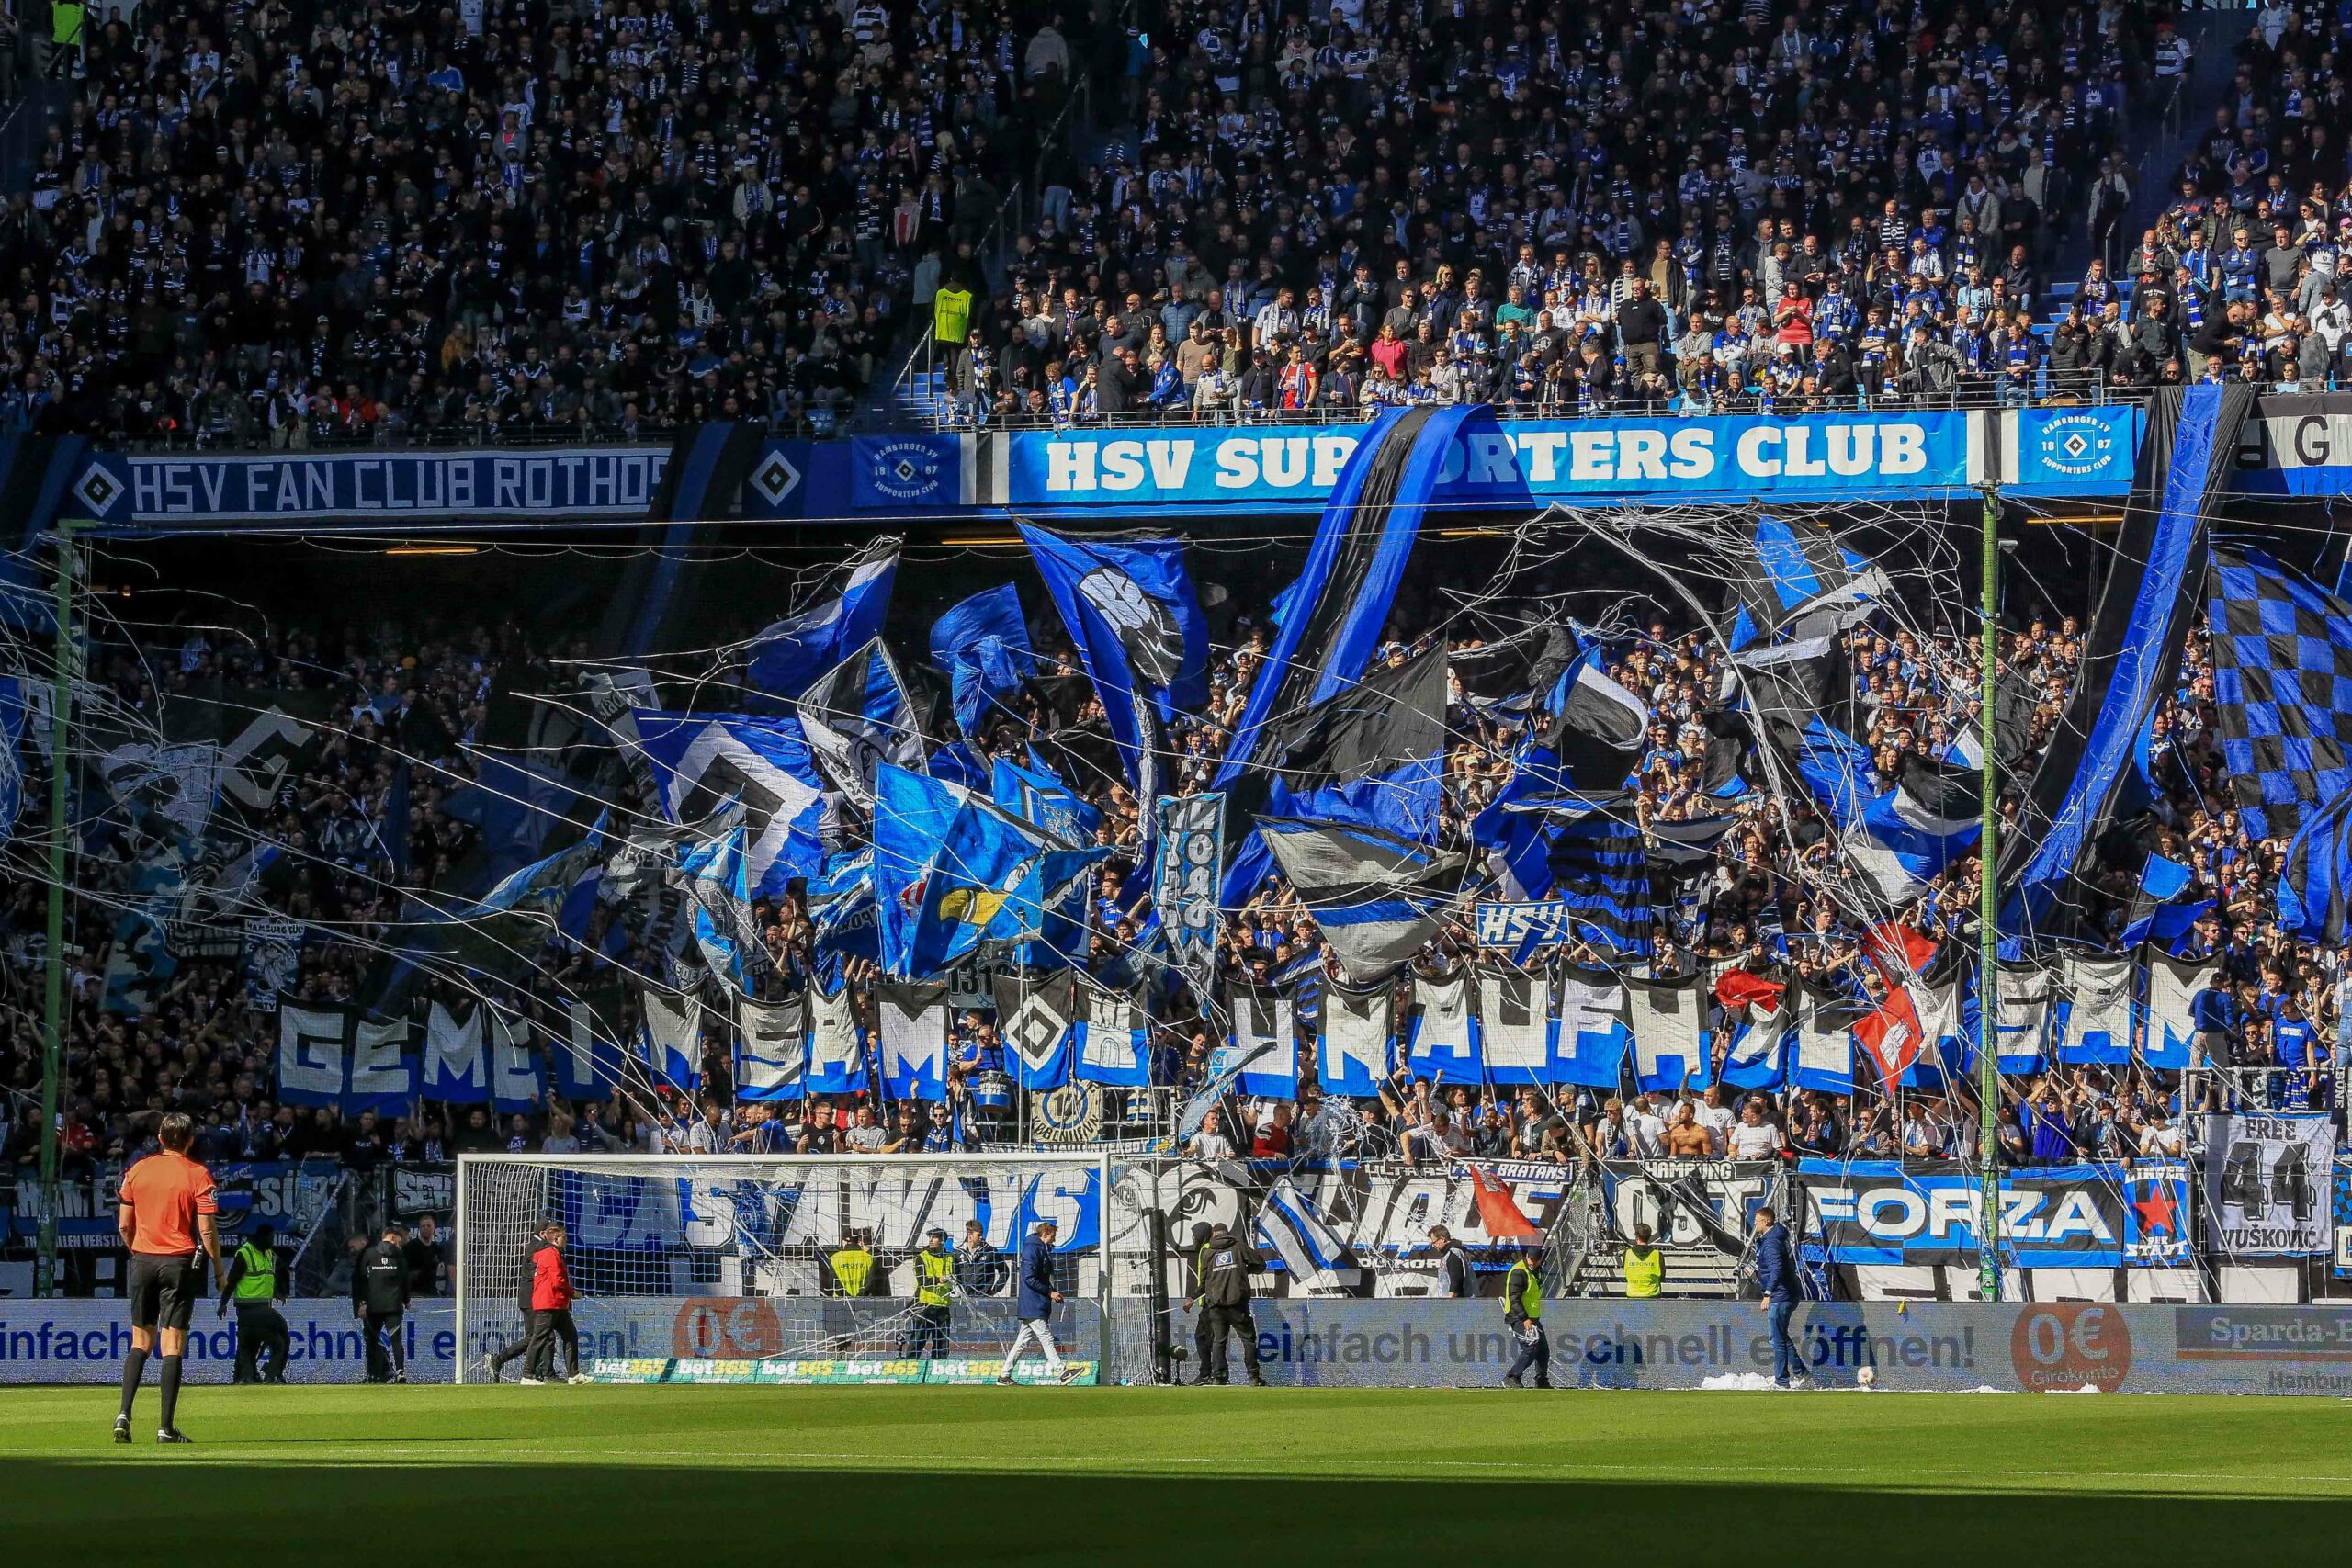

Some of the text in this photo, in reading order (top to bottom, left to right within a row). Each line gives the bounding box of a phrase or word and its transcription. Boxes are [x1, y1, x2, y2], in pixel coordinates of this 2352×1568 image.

[2041, 416, 2111, 435] HAMBURGER SV
[874, 443, 939, 461] HAMBURGER SV
[2041, 441, 2054, 451] 18
[2097, 439, 2111, 449] 87
[1046, 423, 1927, 491] HSV SUPORTERS CLUB
[2041, 454, 2112, 474] SUPPORTERS CLUB
[874, 466, 886, 476] 18
[924, 465, 938, 475] 87
[133, 463, 226, 513] HSV
[246, 460, 334, 511] FAN
[354, 459, 476, 509] CLUB
[874, 479, 939, 497] SUPPORTERS CLUB
[1481, 905, 1564, 941] HSV
[2245, 1118, 2297, 1140] FREE
[1497, 1163, 1569, 1179] BRATANS
[2220, 1141, 2318, 1223] 44
[1806, 1185, 2112, 1240] FORZA
[2222, 1224, 2318, 1249] VUŠKOVIĆ
[2124, 1239, 2188, 1257] STADT
[153, 1321, 237, 1359] nd
[1257, 1322, 1430, 1363] einfach
[1448, 1332, 1521, 1364] un
[2027, 1307, 2109, 1365] 0€
[593, 1358, 665, 1375] bet365
[678, 1358, 750, 1375] bet365
[762, 1358, 833, 1375] bet365
[847, 1359, 920, 1375] bet365
[931, 1359, 1004, 1375] bet365
[2030, 1366, 2120, 1385] Girokonto
